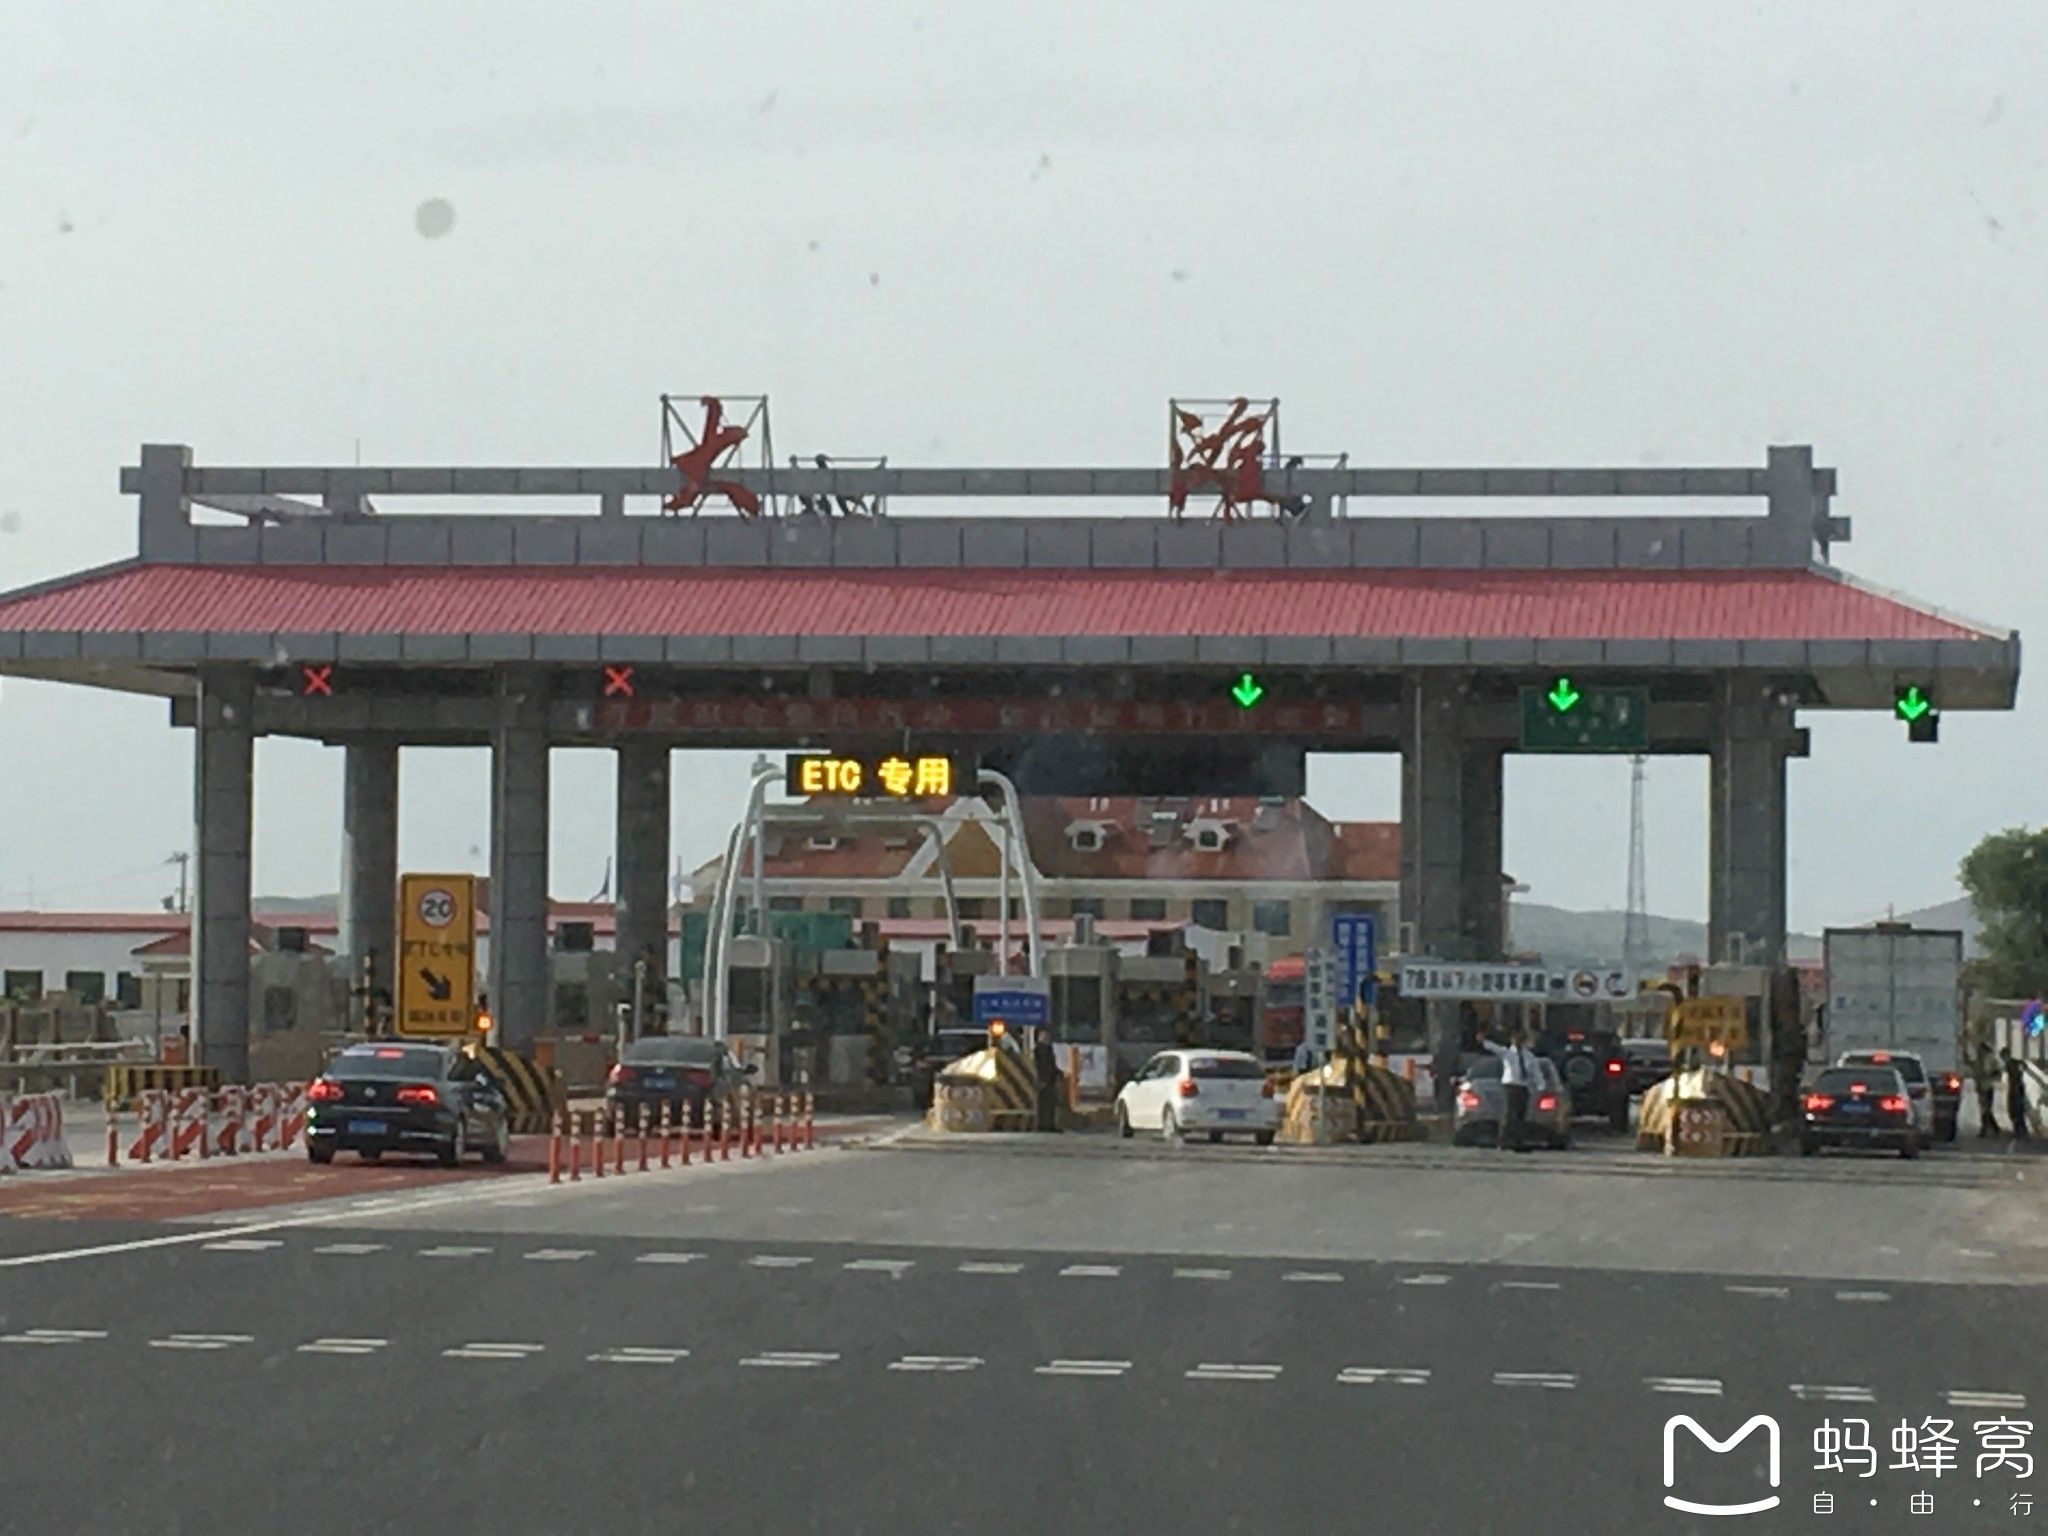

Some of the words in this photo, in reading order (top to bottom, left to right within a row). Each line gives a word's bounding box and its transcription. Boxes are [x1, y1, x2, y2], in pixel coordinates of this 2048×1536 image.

[802, 758, 863, 792] ETC
[877, 756, 949, 796] 专用
[423, 899, 453, 919] 20
